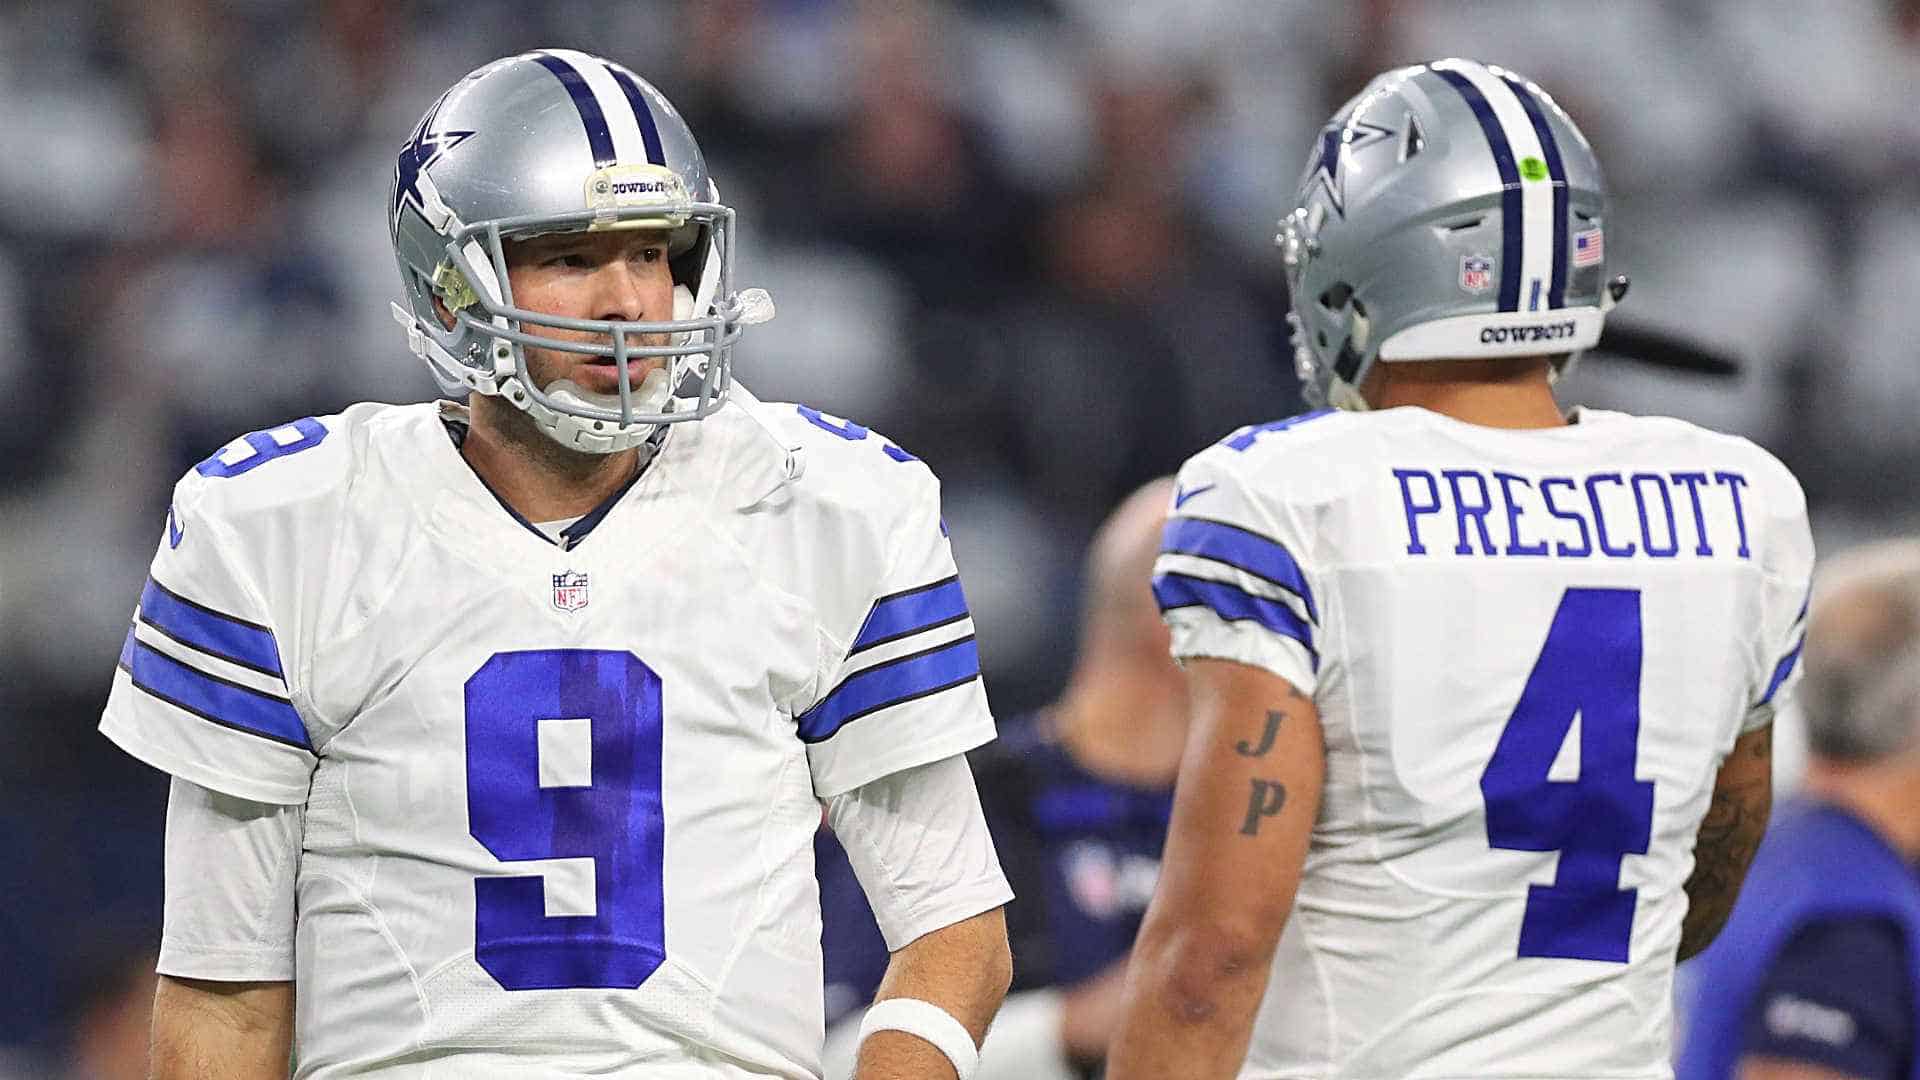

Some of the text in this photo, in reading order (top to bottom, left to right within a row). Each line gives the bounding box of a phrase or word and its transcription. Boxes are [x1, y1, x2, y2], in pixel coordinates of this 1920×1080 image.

[1481, 321, 1575, 343] COWBOYS
[1392, 469, 1752, 559] PRESCOTT
[556, 588, 586, 607] NFL
[1236, 709, 1287, 757] J
[1480, 586, 1656, 964] 4
[464, 648, 666, 991] 9
[1240, 779, 1286, 835] P
